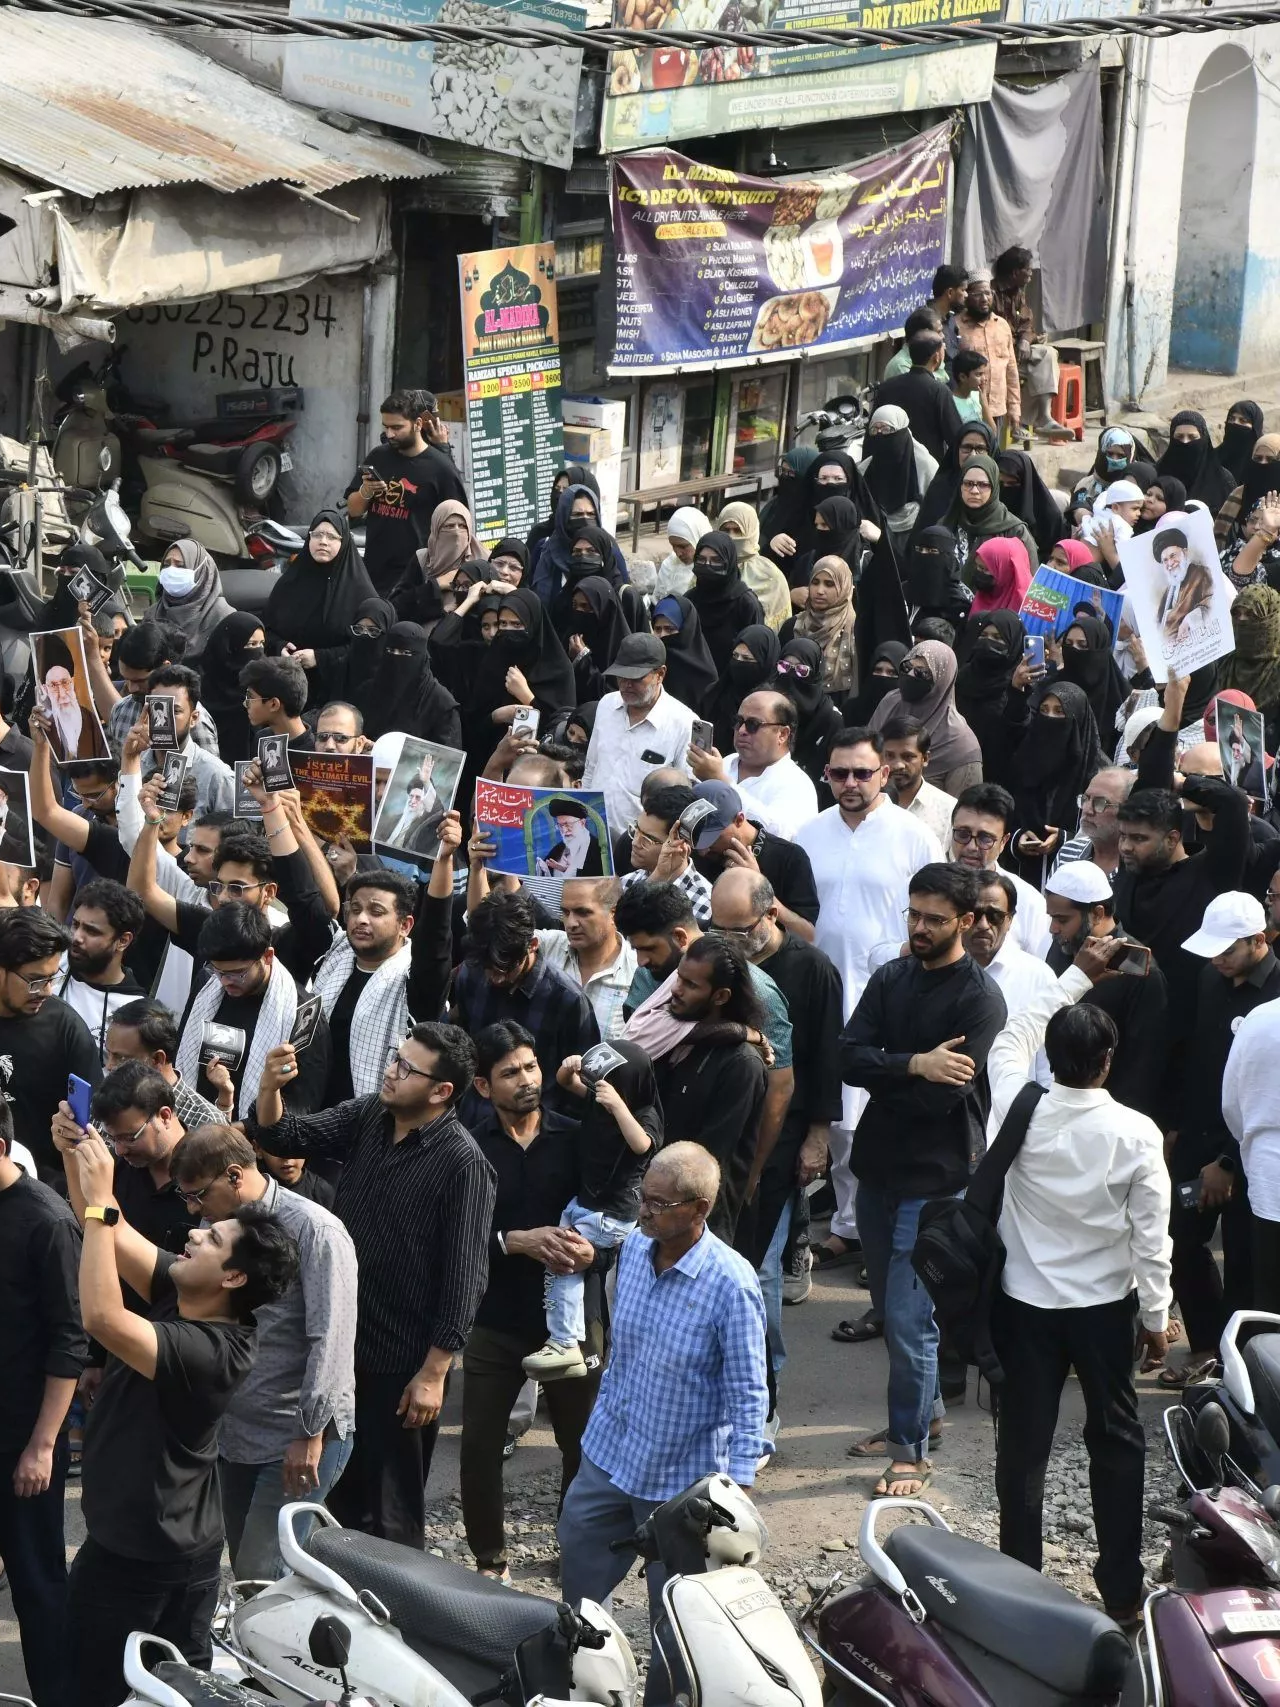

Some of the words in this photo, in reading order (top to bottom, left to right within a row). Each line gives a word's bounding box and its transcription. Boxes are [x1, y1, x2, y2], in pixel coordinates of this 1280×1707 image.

[862, 5, 891, 28] DRY
[892, 0, 939, 27] FRUITS
[941, 1, 951, 20] &
[302, 74, 364, 96] WHOLESALE
[377, 90, 412, 107] RETAIL
[743, 95, 785, 109] UNDERTAKE
[797, 92, 831, 104] FUNCTION
[838, 88, 869, 100] CATERING
[869, 85, 897, 97] ORDERS
[632, 210, 652, 223] ALL
[654, 210, 670, 223] DRY
[670, 210, 697, 222] FRUITS
[725, 210, 748, 221] HERE
[731, 307, 752, 316] HONEY
[710, 322, 725, 331] ASLI
[725, 320, 751, 329] ZAFRAN
[468, 368, 496, 381] RAMZAN
[497, 364, 525, 377] SPECIAL
[526, 359, 560, 372] PACKAGES
[483, 383, 499, 394] 1200
[514, 378, 530, 388] 2500
[545, 372, 561, 384] 3600
[294, 767, 309, 777] THE
[312, 770, 349, 781] ULTIMATE
[306, 756, 350, 773] israel
[840, 1641, 894, 1684] Activa
[280, 1655, 358, 1694] Activa
